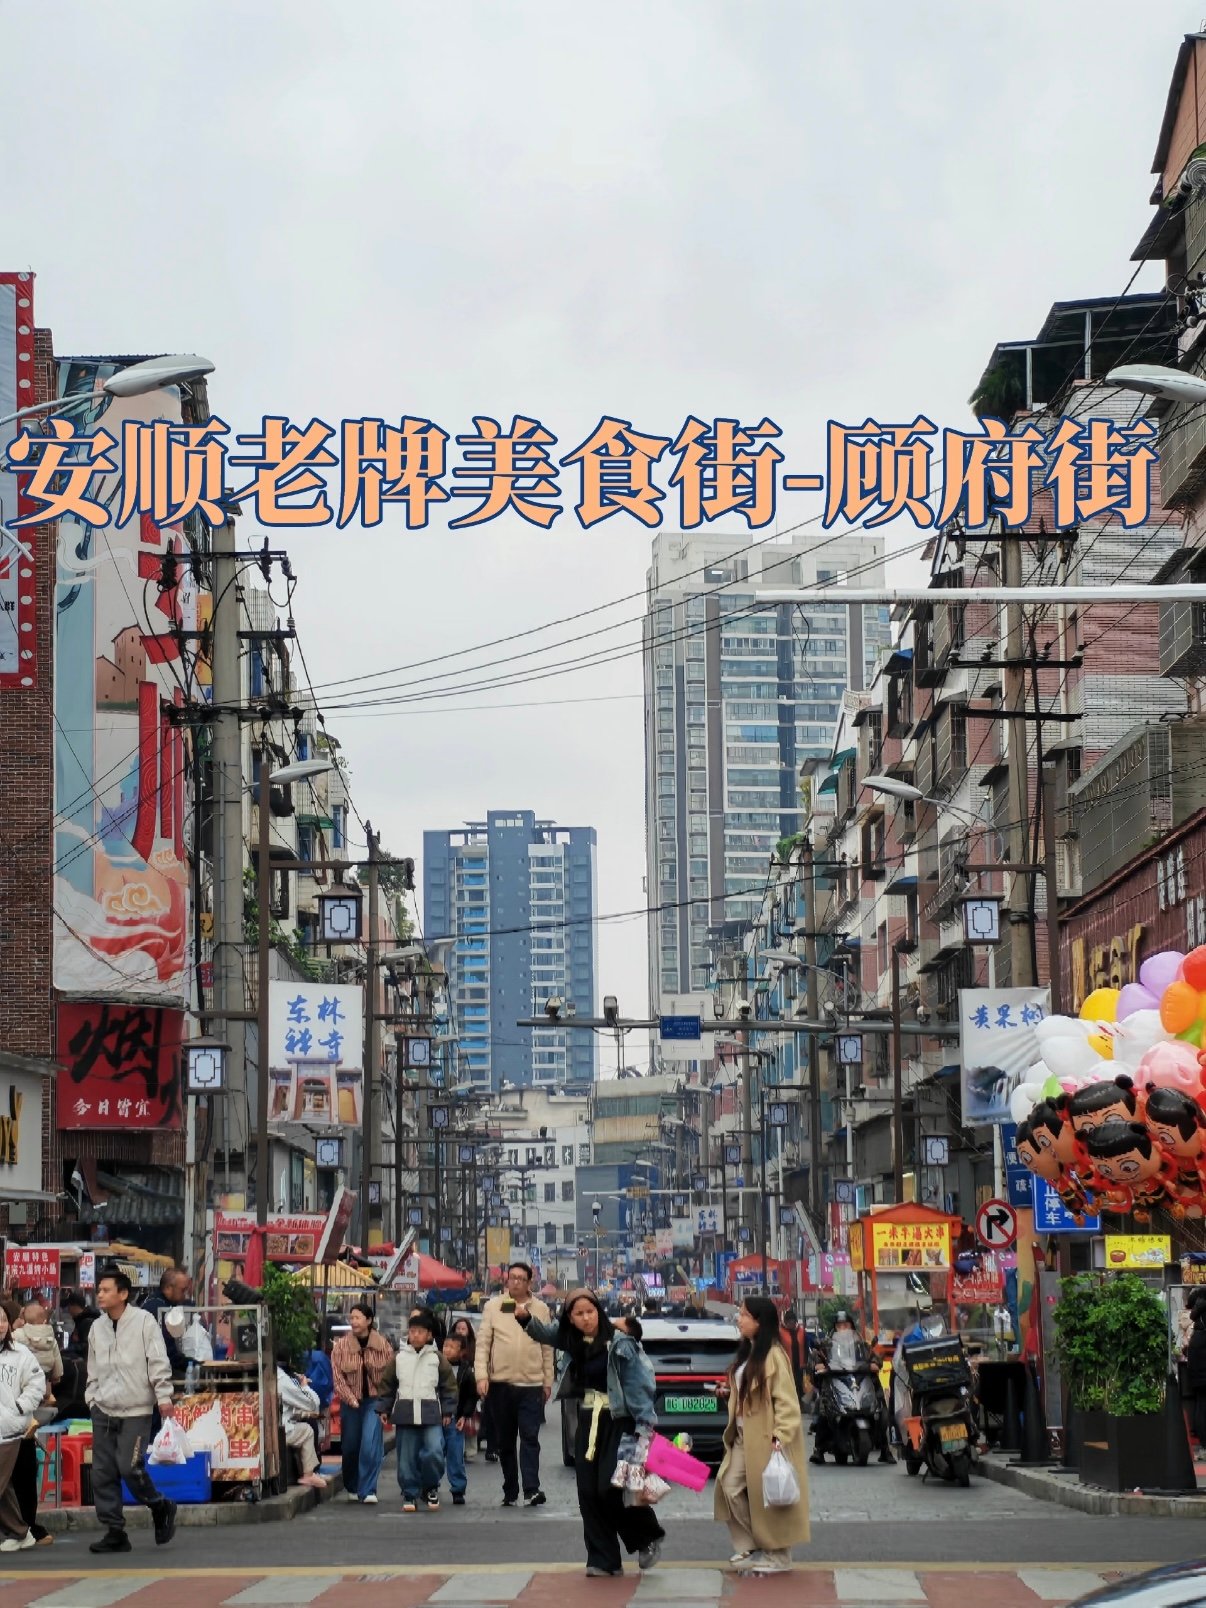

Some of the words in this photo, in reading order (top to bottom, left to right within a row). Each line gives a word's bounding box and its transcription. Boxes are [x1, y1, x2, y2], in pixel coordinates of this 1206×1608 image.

[286, 994, 346, 1025] 东林
[968, 1004, 1045, 1028] 黄果树
[285, 1026, 345, 1060] 禅寺
